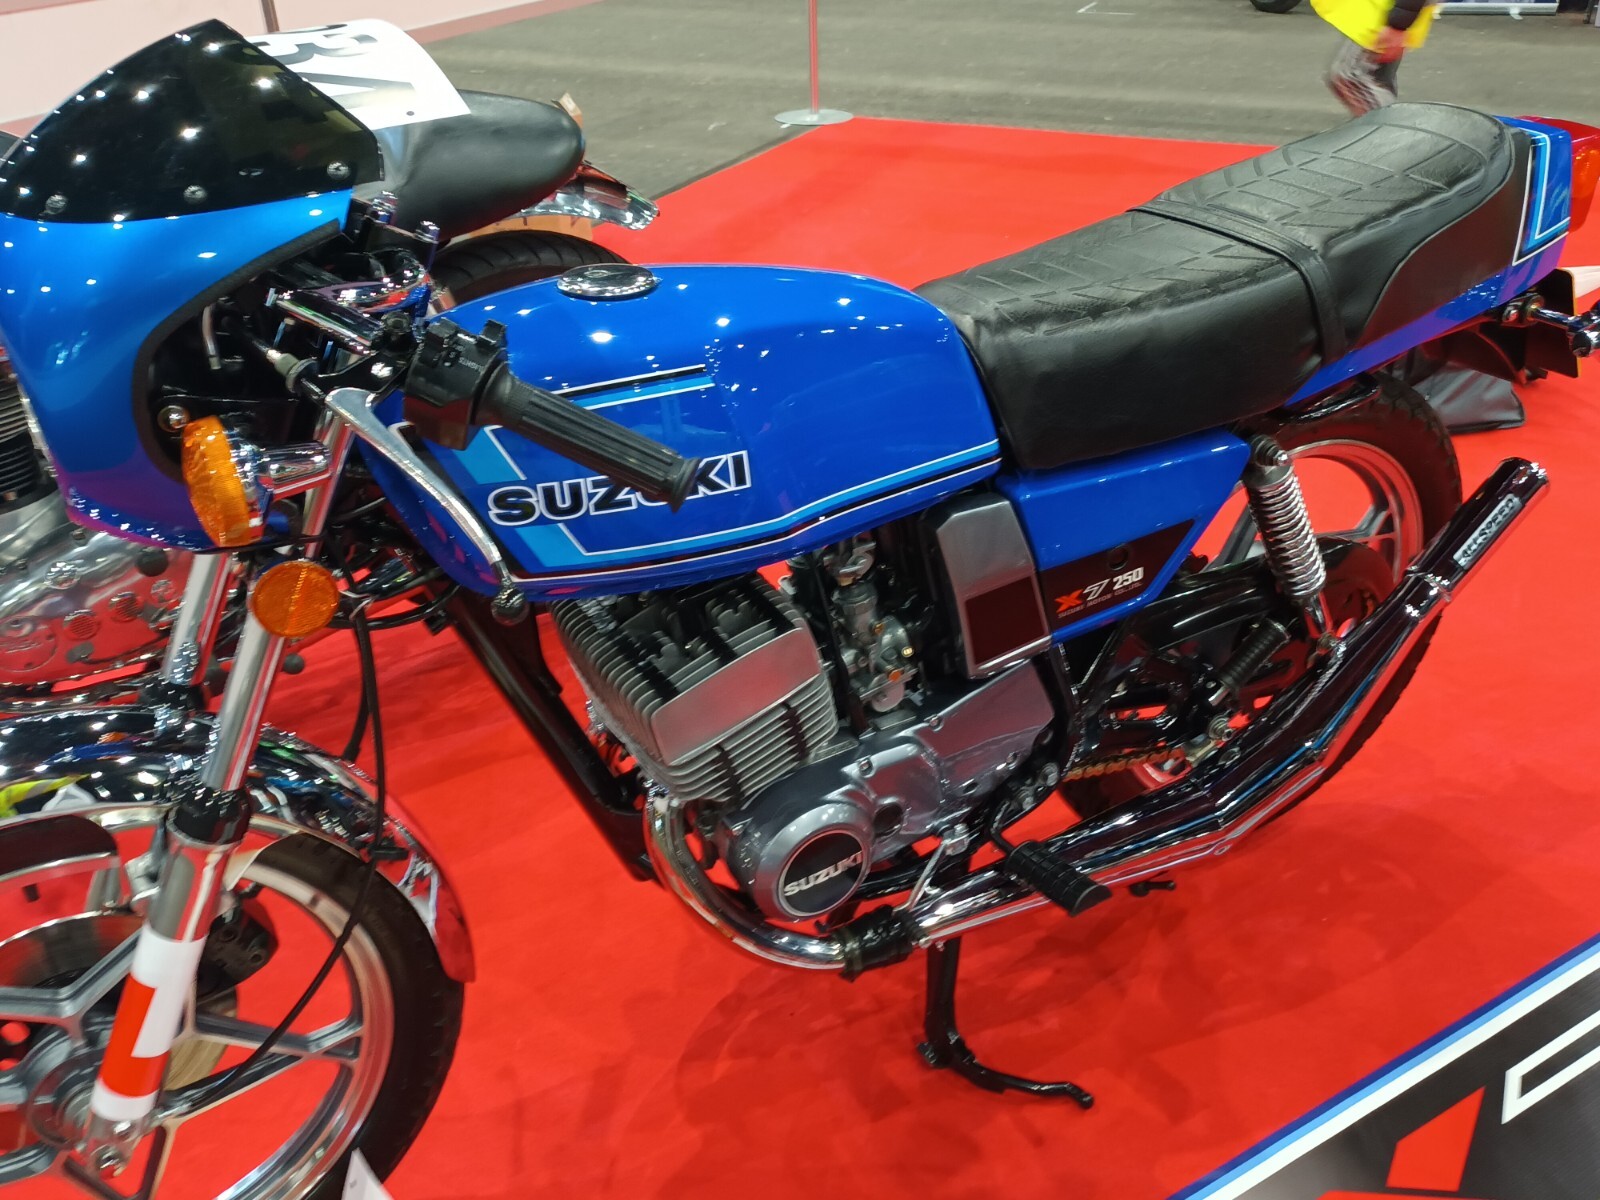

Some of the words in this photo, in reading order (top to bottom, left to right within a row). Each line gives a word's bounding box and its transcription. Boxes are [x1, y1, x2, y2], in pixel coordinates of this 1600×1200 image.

[488, 450, 751, 526] SUZKI
[1113, 567, 1144, 590] 250
[784, 851, 863, 896] SUZUKI
